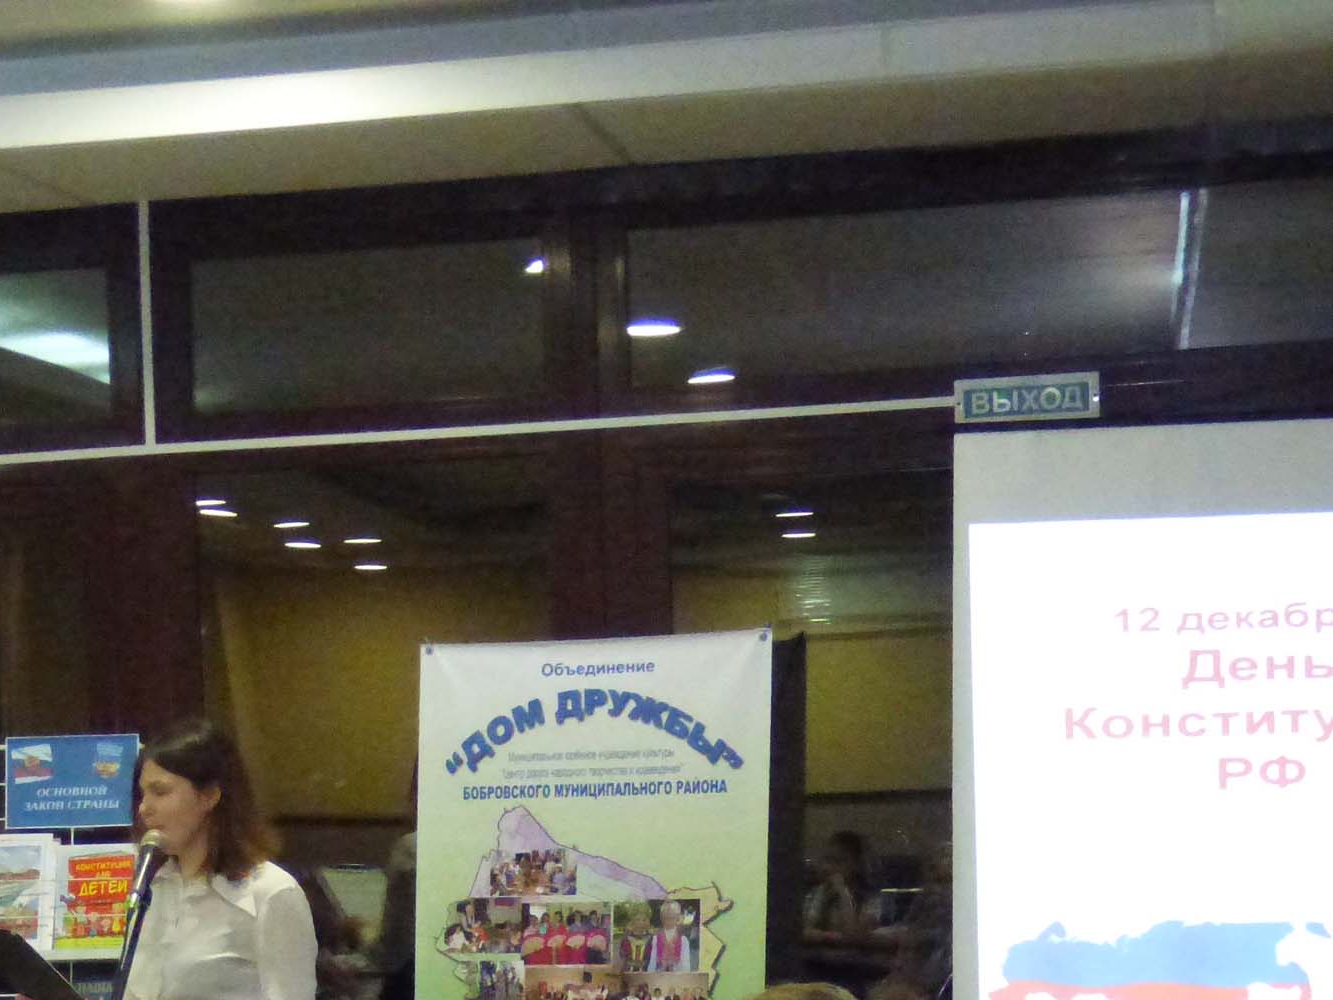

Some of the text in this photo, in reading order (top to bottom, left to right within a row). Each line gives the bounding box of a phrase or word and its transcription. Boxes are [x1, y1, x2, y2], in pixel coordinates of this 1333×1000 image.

[971, 386, 1084, 415] ВЫХОД
[1114, 602, 1333, 635] 12 декабр
[541, 660, 656, 678] Объединение
[1181, 649, 1333, 689] День
[1064, 706, 1333, 742] Конститу
[1218, 755, 1306, 789] РФ
[37, 784, 108, 797] ОСНОВНОЙ
[463, 777, 727, 800] БОБРОВСКОГО МУНИЦИПАЛЬНОГО РАЙОНА
[26, 799, 120, 811] ЗАКОН СТРАНЫ
